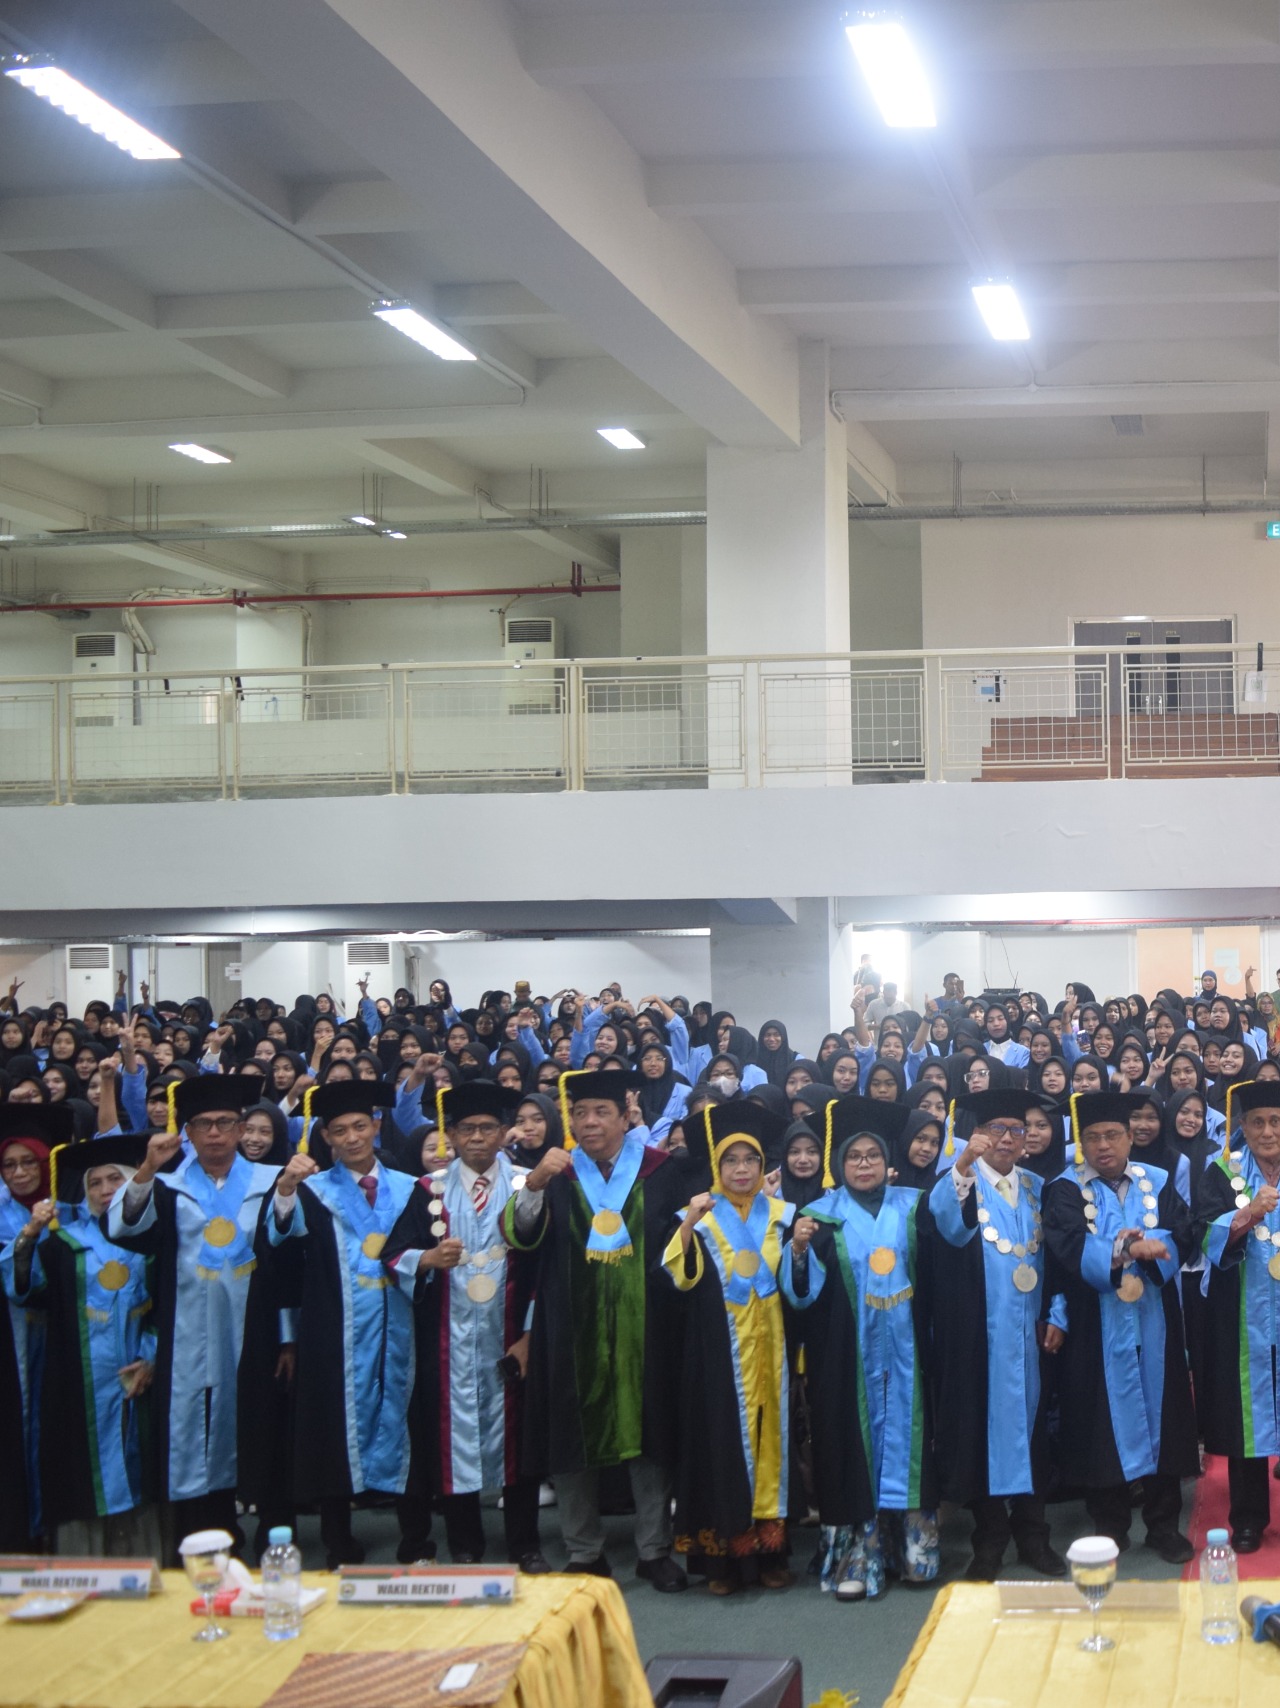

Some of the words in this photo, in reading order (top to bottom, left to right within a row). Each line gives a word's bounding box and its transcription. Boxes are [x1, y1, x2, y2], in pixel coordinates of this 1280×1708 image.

[21, 1576, 50, 1588] WAKIL
[53, 1576, 89, 1587] REKTOR
[377, 1584, 408, 1595] WAKIL
[411, 1583, 449, 1595] REKTOR
